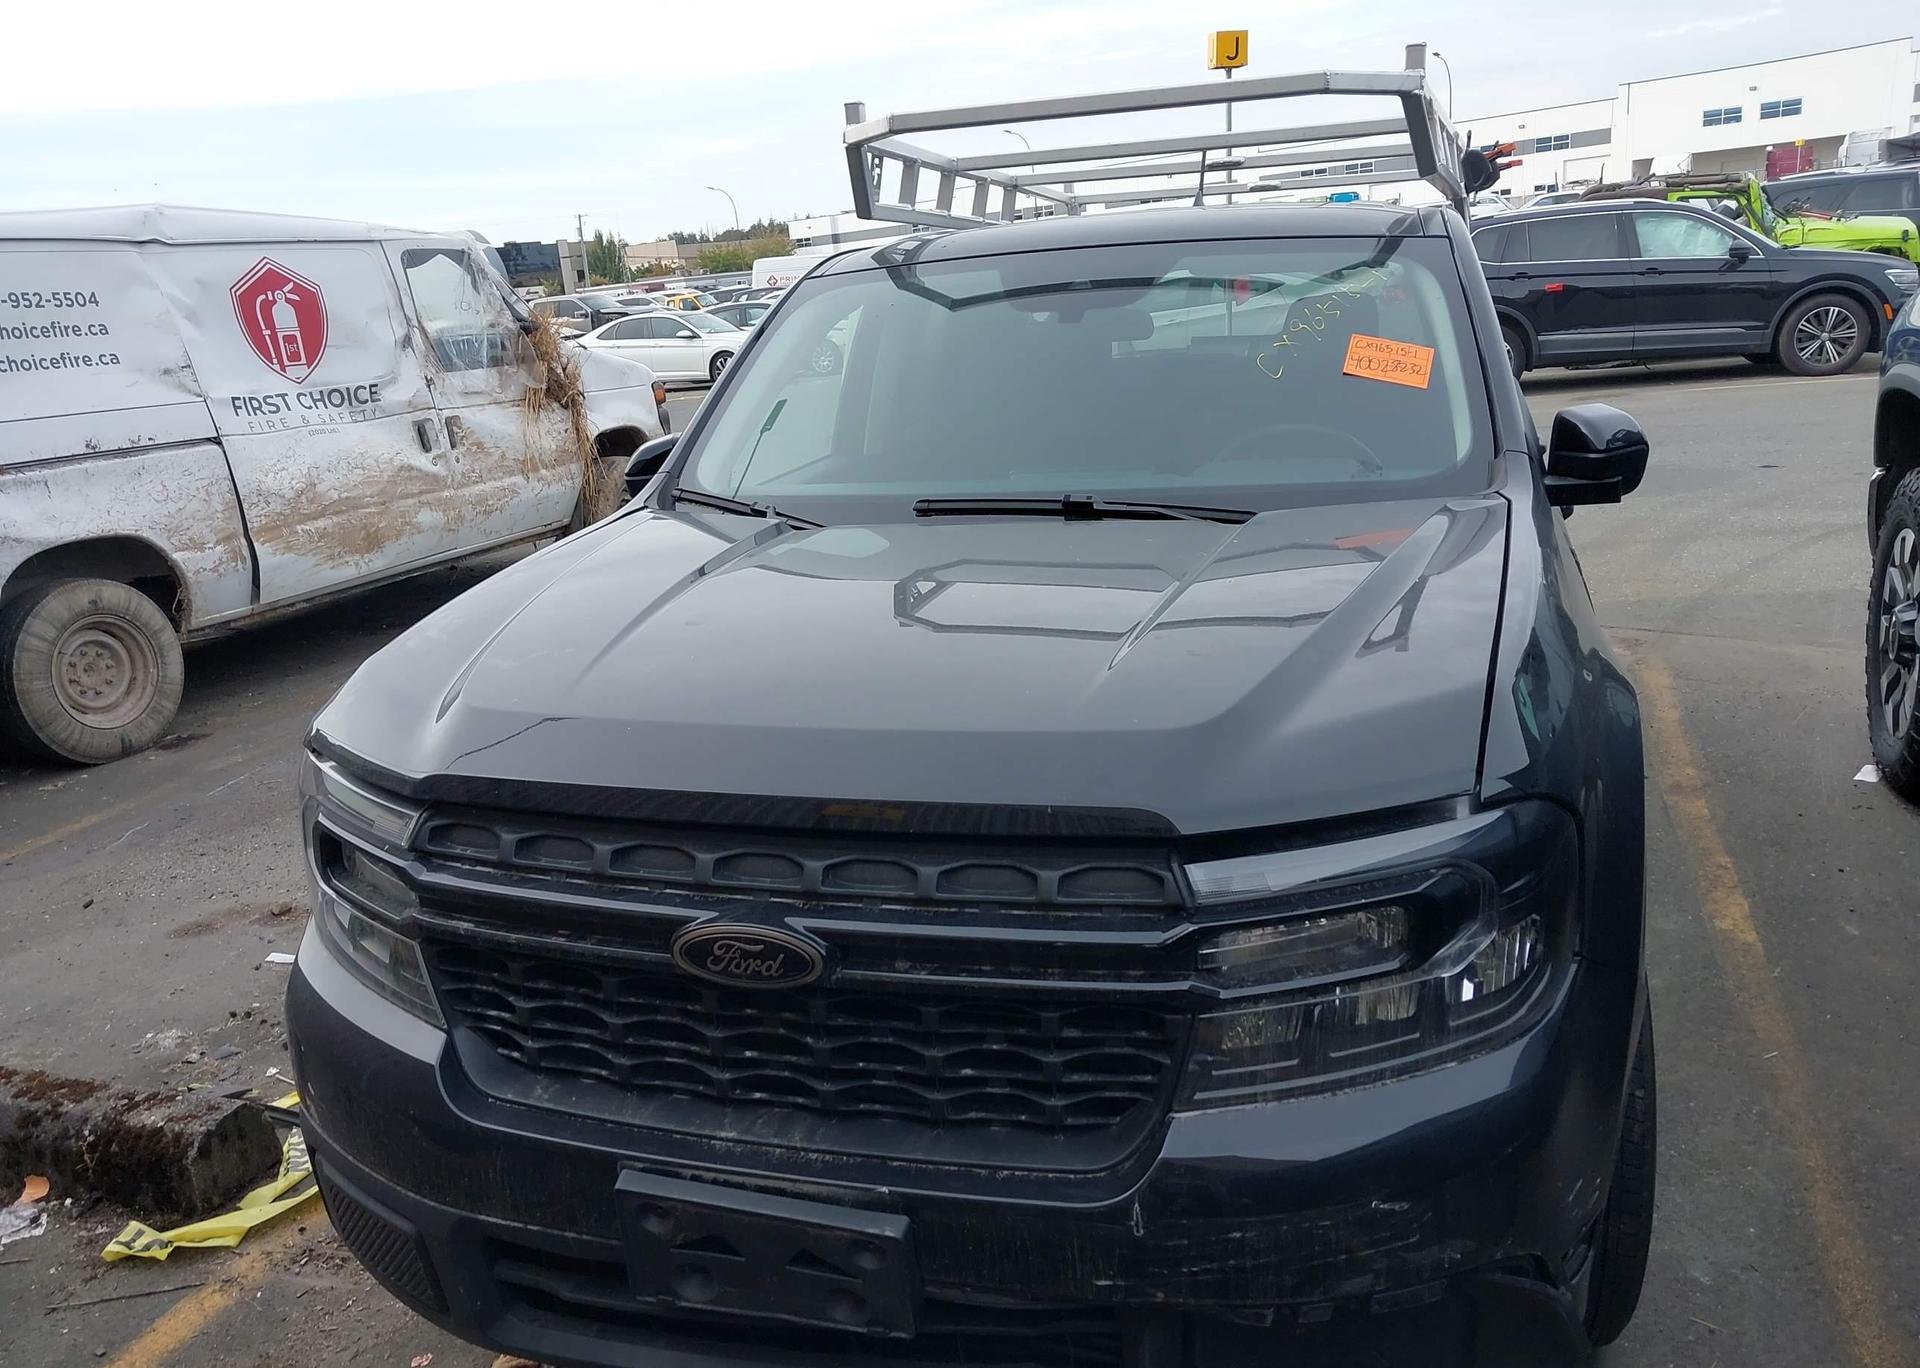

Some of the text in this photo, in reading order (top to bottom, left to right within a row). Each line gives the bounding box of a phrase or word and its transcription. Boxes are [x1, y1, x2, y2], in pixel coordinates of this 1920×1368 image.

[1226, 36, 1240, 60] J
[231, 383, 382, 417] FIRST CHOICE
[247, 407, 378, 432] FIRE & SAFETY
[706, 939, 785, 977] Ford
